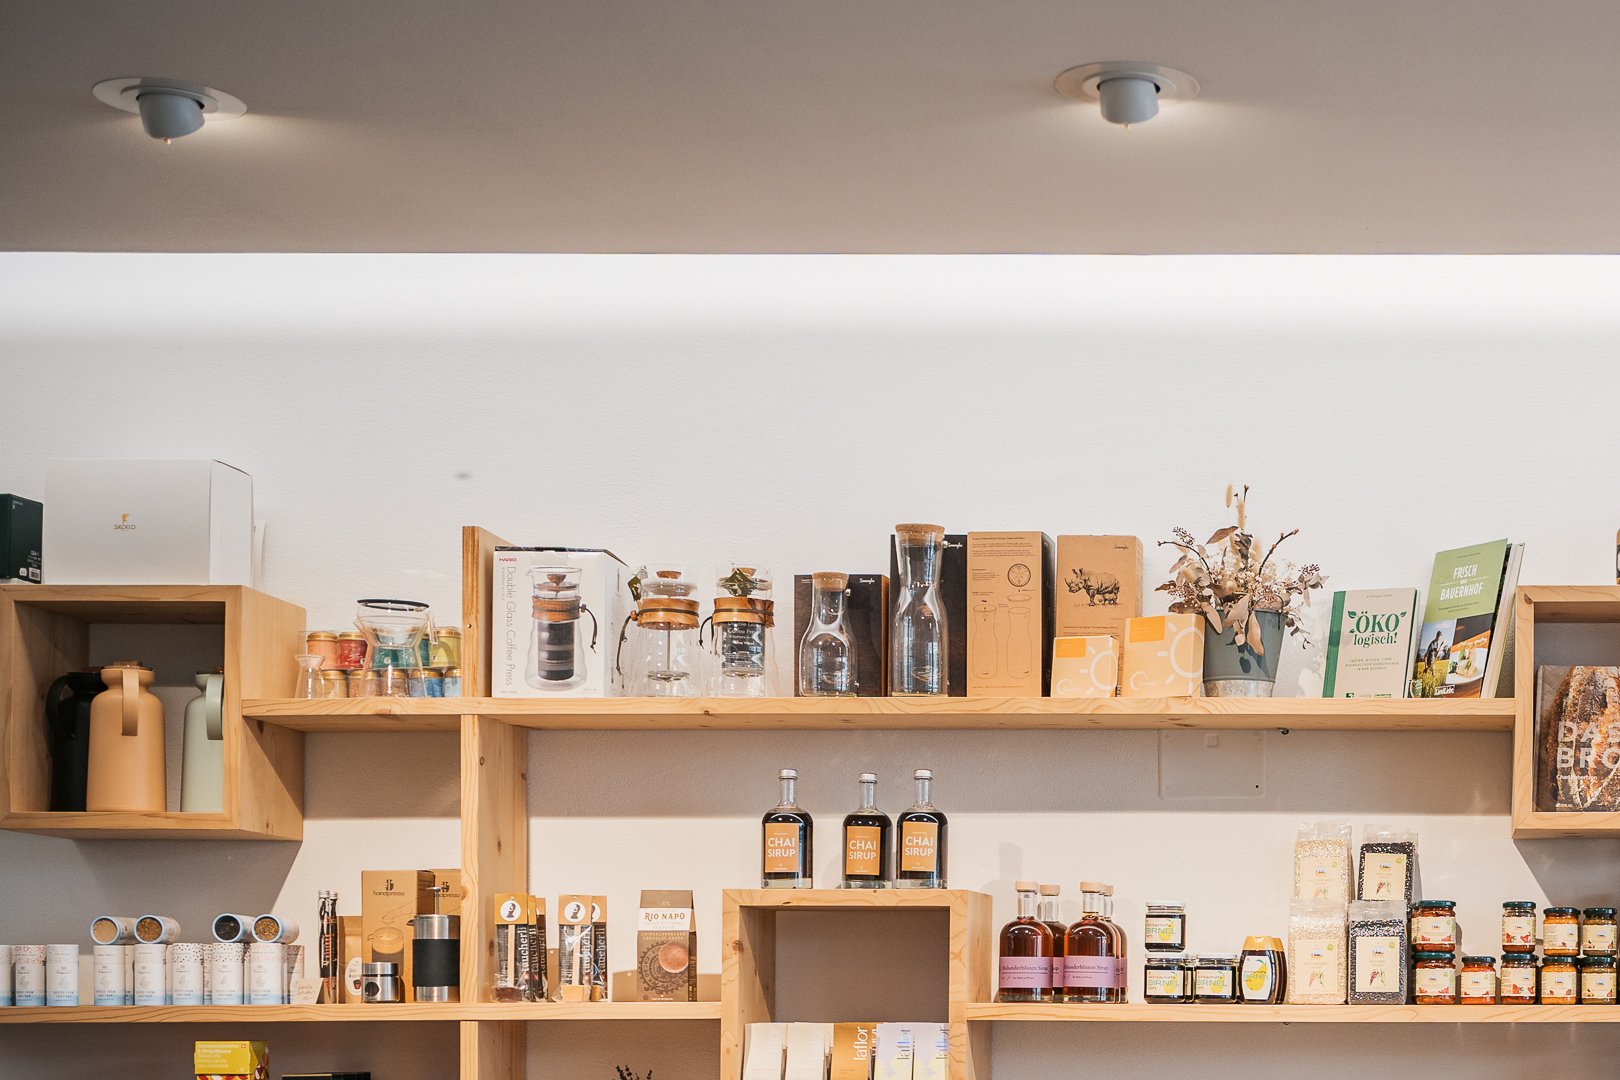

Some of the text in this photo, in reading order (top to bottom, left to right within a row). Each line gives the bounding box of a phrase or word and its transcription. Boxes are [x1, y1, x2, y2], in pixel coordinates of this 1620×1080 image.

[1453, 564, 1478, 578] FRISCH
[1439, 582, 1484, 601] BAUERNHOF
[505, 566, 516, 687] Double Glass Coffee Press
[1355, 611, 1400, 634] ÖKO
[1353, 632, 1398, 649] logisch!
[768, 837, 795, 848] CHAI
[849, 840, 877, 850] CHAI
[905, 836, 934, 847] CHAI
[767, 848, 796, 858] SIRUP
[849, 850, 877, 860] SIRUP
[904, 847, 934, 857] SIRUP
[372, 890, 405, 898] handpresso
[644, 911, 686, 922] RIO NAPO
[517, 926, 530, 972] taucherli
[1147, 979, 1180, 987] BIRNEL
[1196, 979, 1228, 987] BIRNEL
[852, 1025, 869, 1061] laflor
